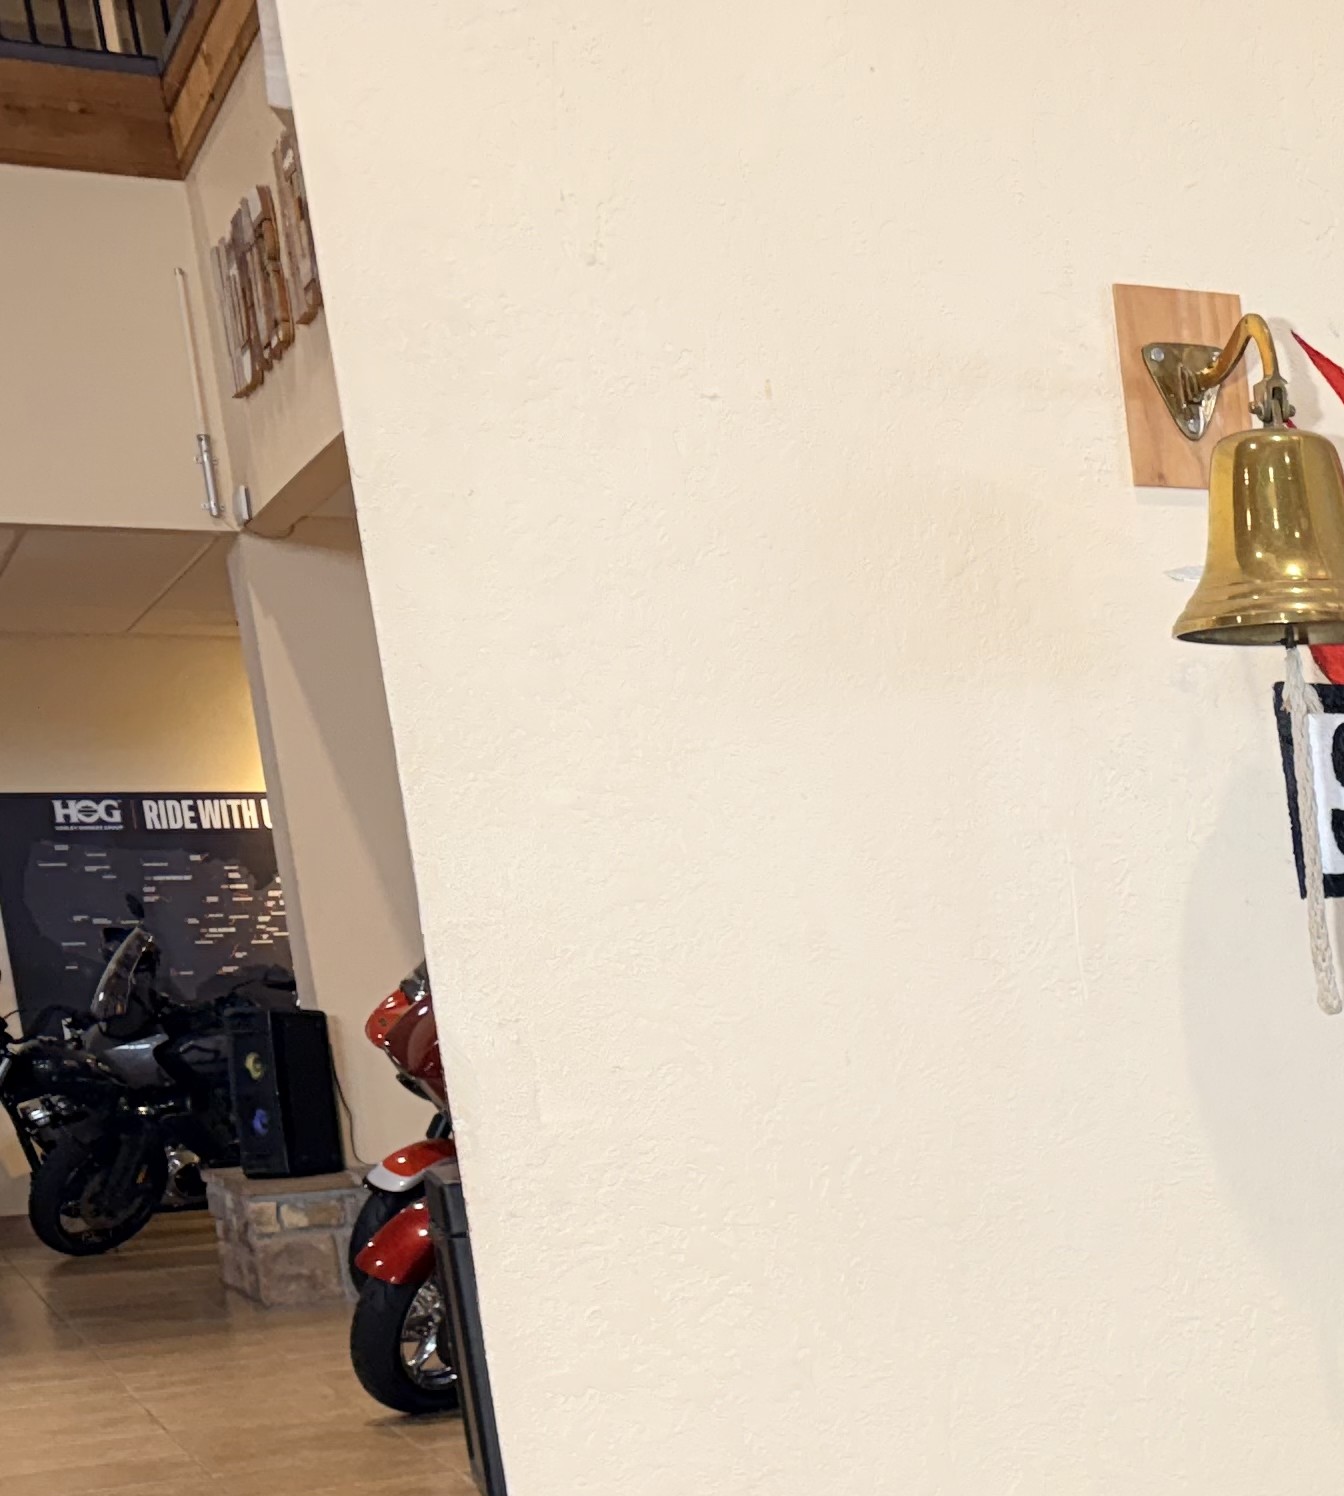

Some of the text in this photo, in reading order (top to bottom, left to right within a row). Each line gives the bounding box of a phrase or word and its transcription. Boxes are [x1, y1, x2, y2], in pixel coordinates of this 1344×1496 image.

[52, 799, 122, 823] HOG
[142, 799, 198, 830] RIDE
[197, 799, 260, 830] WITH
